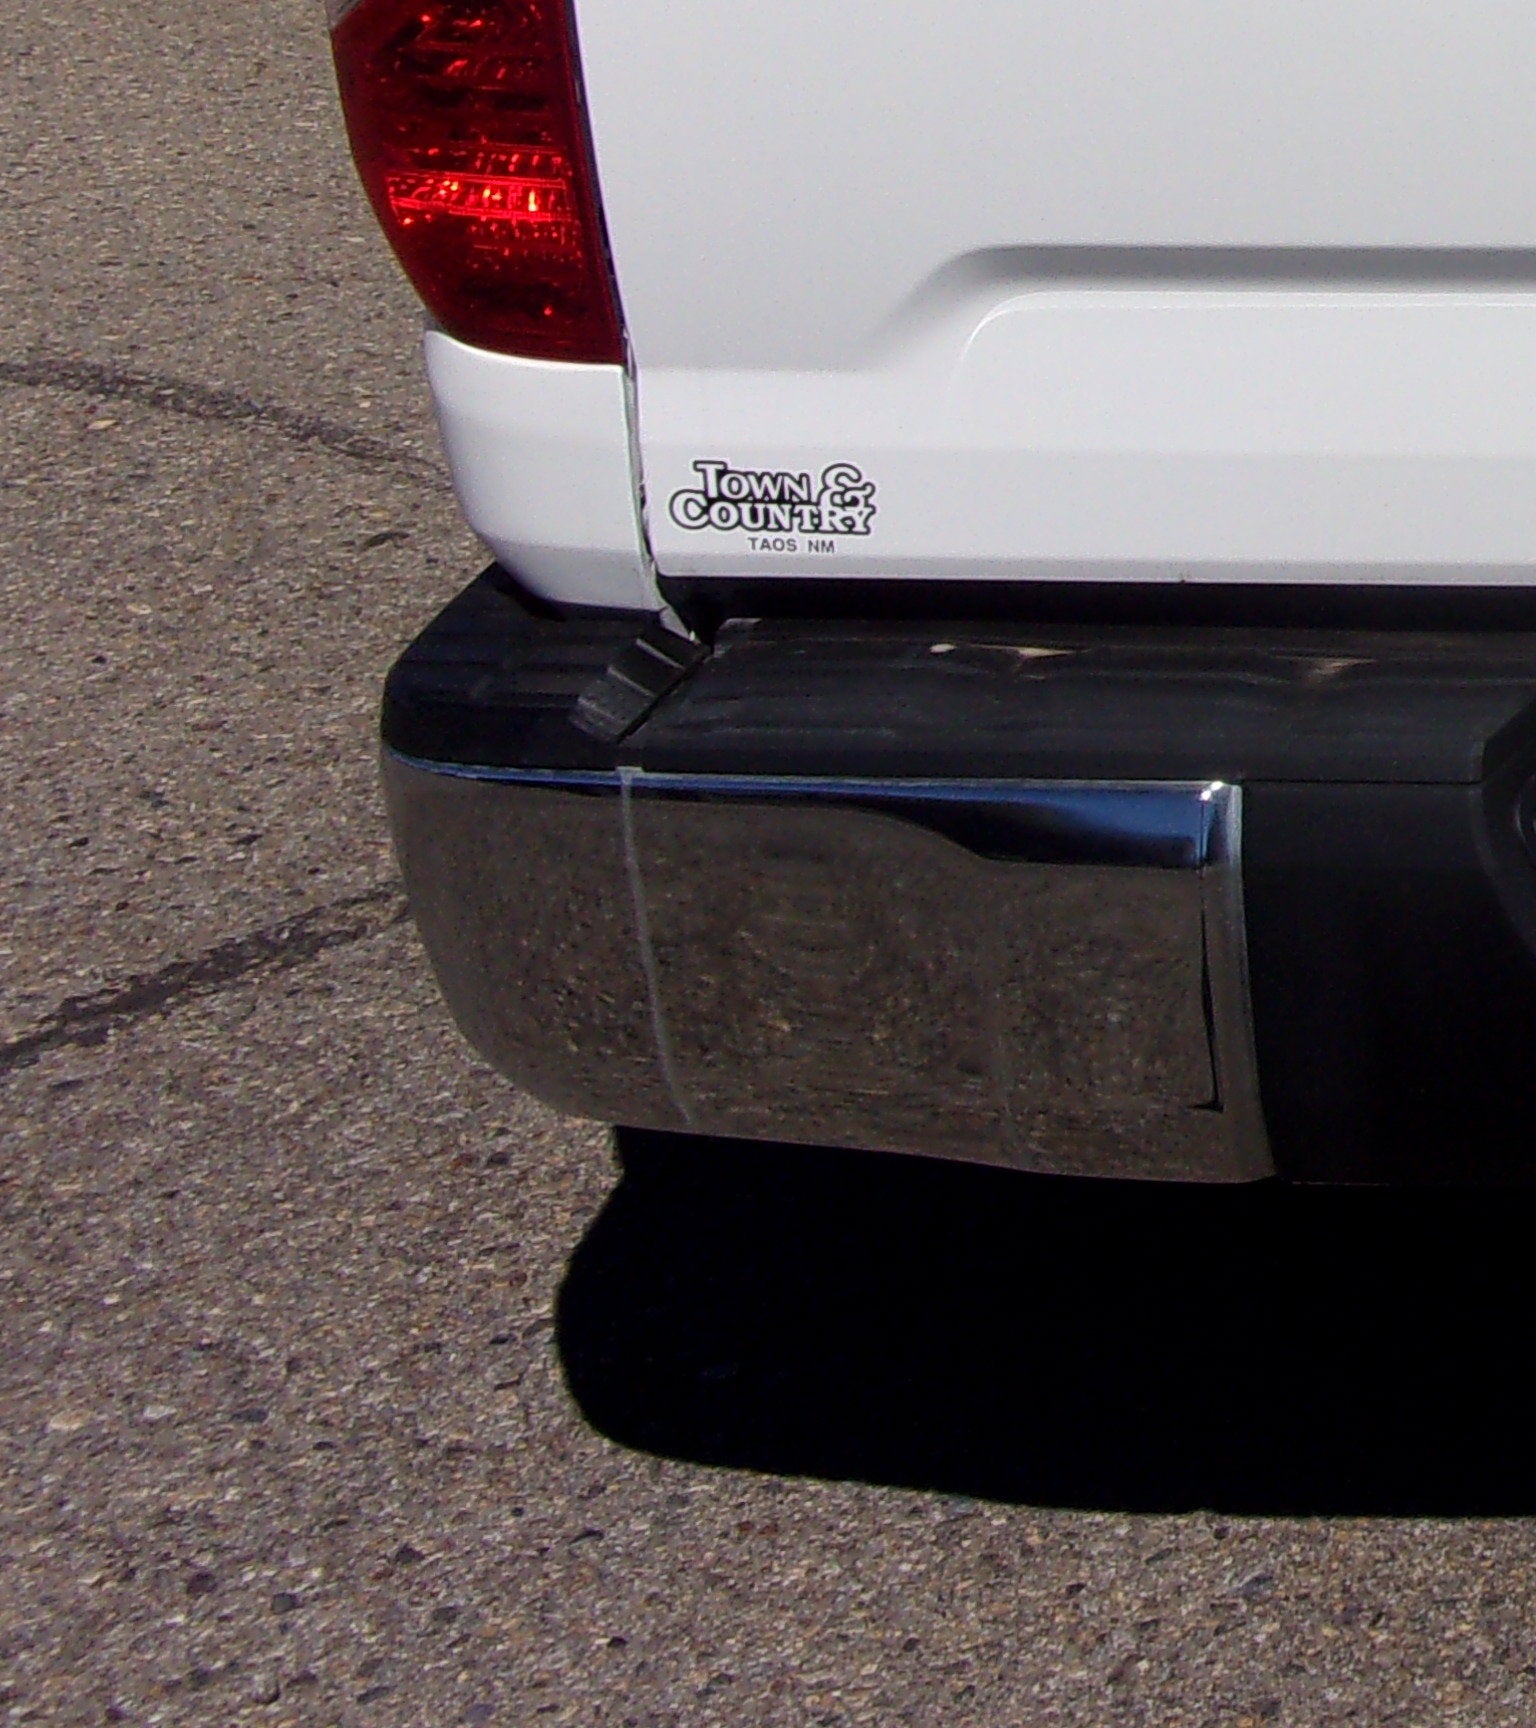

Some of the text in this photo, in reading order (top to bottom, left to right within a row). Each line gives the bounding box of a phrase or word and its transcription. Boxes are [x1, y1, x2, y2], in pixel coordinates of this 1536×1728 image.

[820, 463, 876, 508] &
[747, 537, 836, 554] TAOS NM
